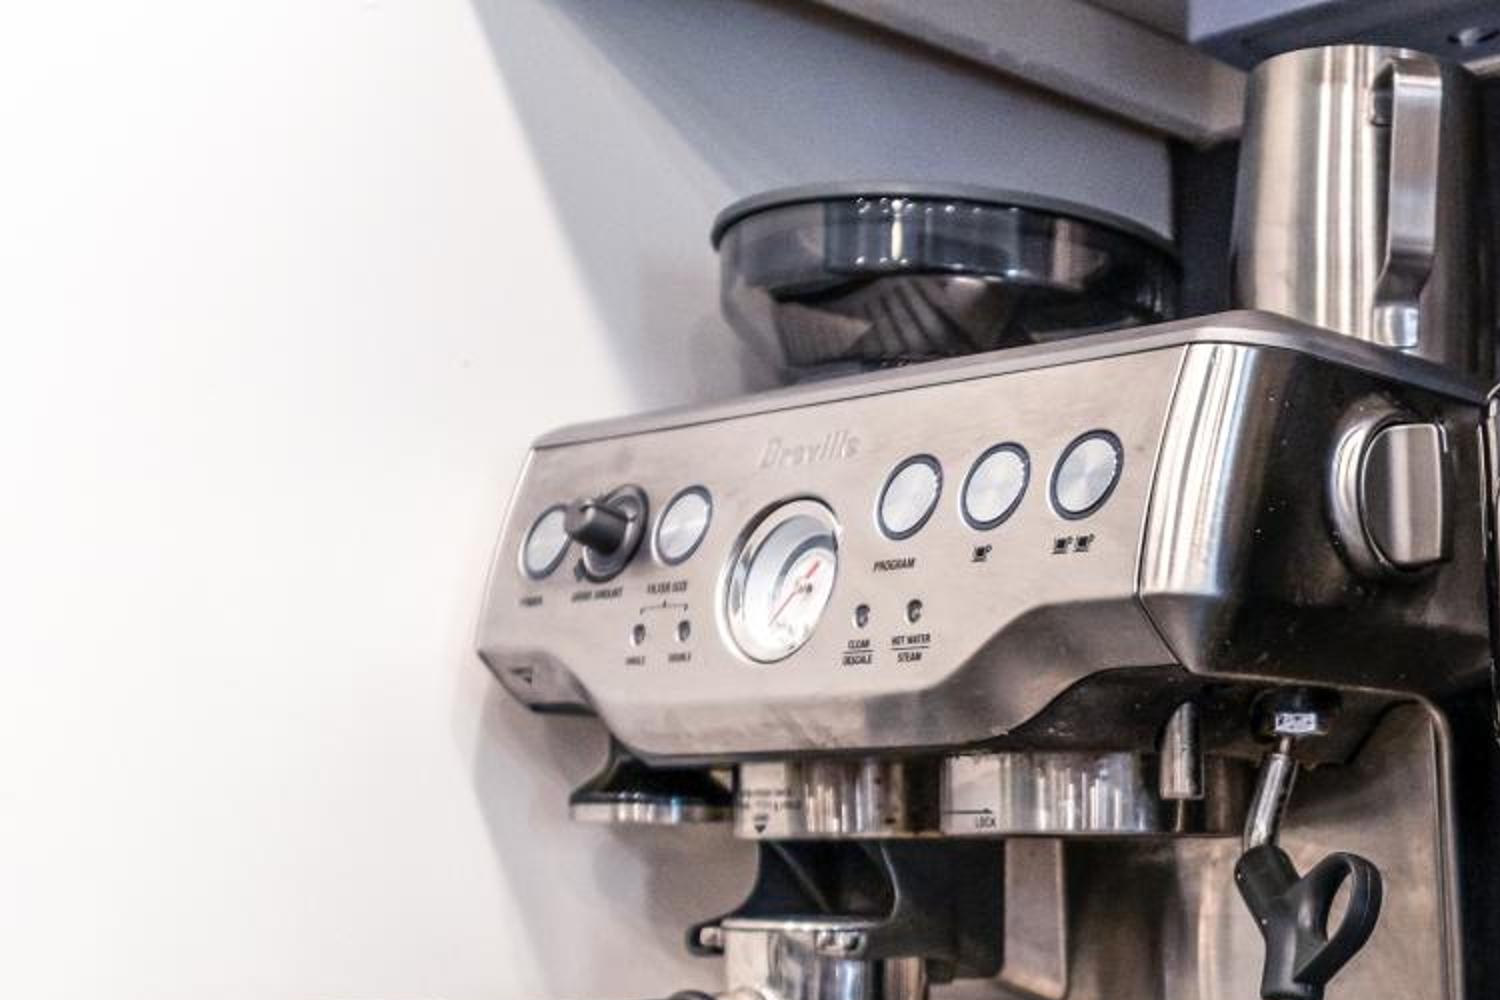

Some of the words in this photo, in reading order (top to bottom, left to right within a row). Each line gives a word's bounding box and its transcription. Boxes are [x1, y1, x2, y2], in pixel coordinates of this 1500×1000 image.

[873, 557, 916, 572] PROGRAM
[897, 651, 923, 663] STEAM
[975, 816, 997, 829] LOCK
